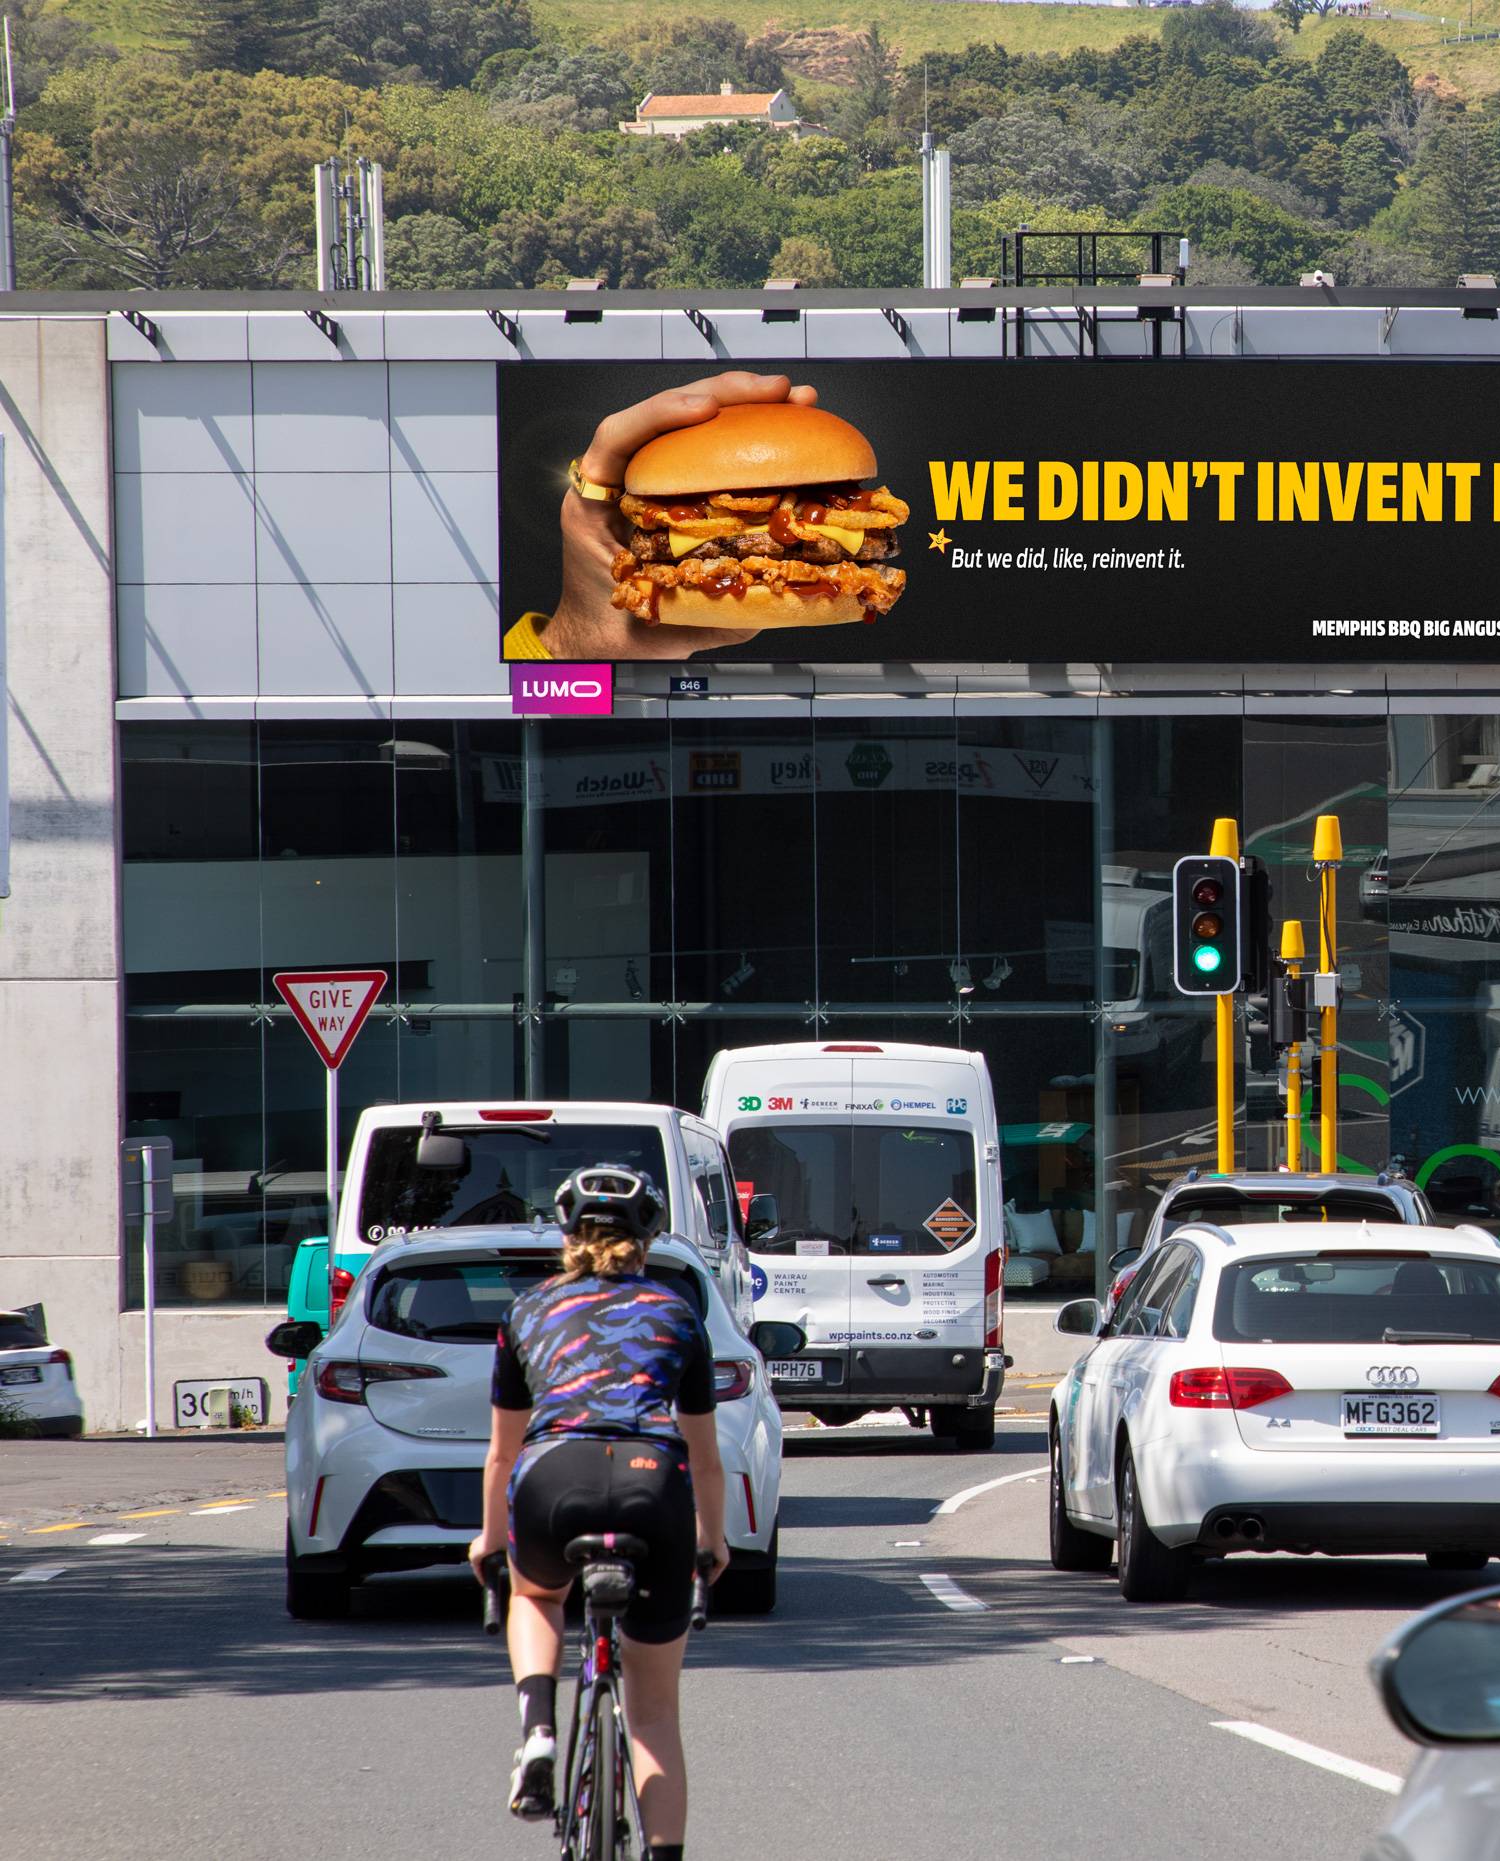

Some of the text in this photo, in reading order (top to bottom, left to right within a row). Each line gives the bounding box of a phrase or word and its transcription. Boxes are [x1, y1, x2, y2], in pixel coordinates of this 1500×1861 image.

[928, 461, 1025, 521] WE
[1257, 461, 1481, 522] INVENT
[951, 548, 1185, 571] But we did, like, reinvent it.
[1312, 620, 1386, 636] MEMPHIS
[1388, 620, 1421, 639] BBQ
[1424, 620, 1450, 636] BIG
[522, 680, 602, 698] LUMO
[680, 681, 700, 690] 646
[309, 989, 353, 1009] GIVE
[317, 1016, 345, 1031] WAY
[738, 1096, 762, 1112] 3D
[768, 1097, 793, 1111] 3M
[828, 1329, 912, 1342] wpcpaints.co.nz
[772, 1362, 816, 1378] HPH76
[1346, 1401, 1435, 1425] MFG362
[629, 1456, 658, 1470] dhb
